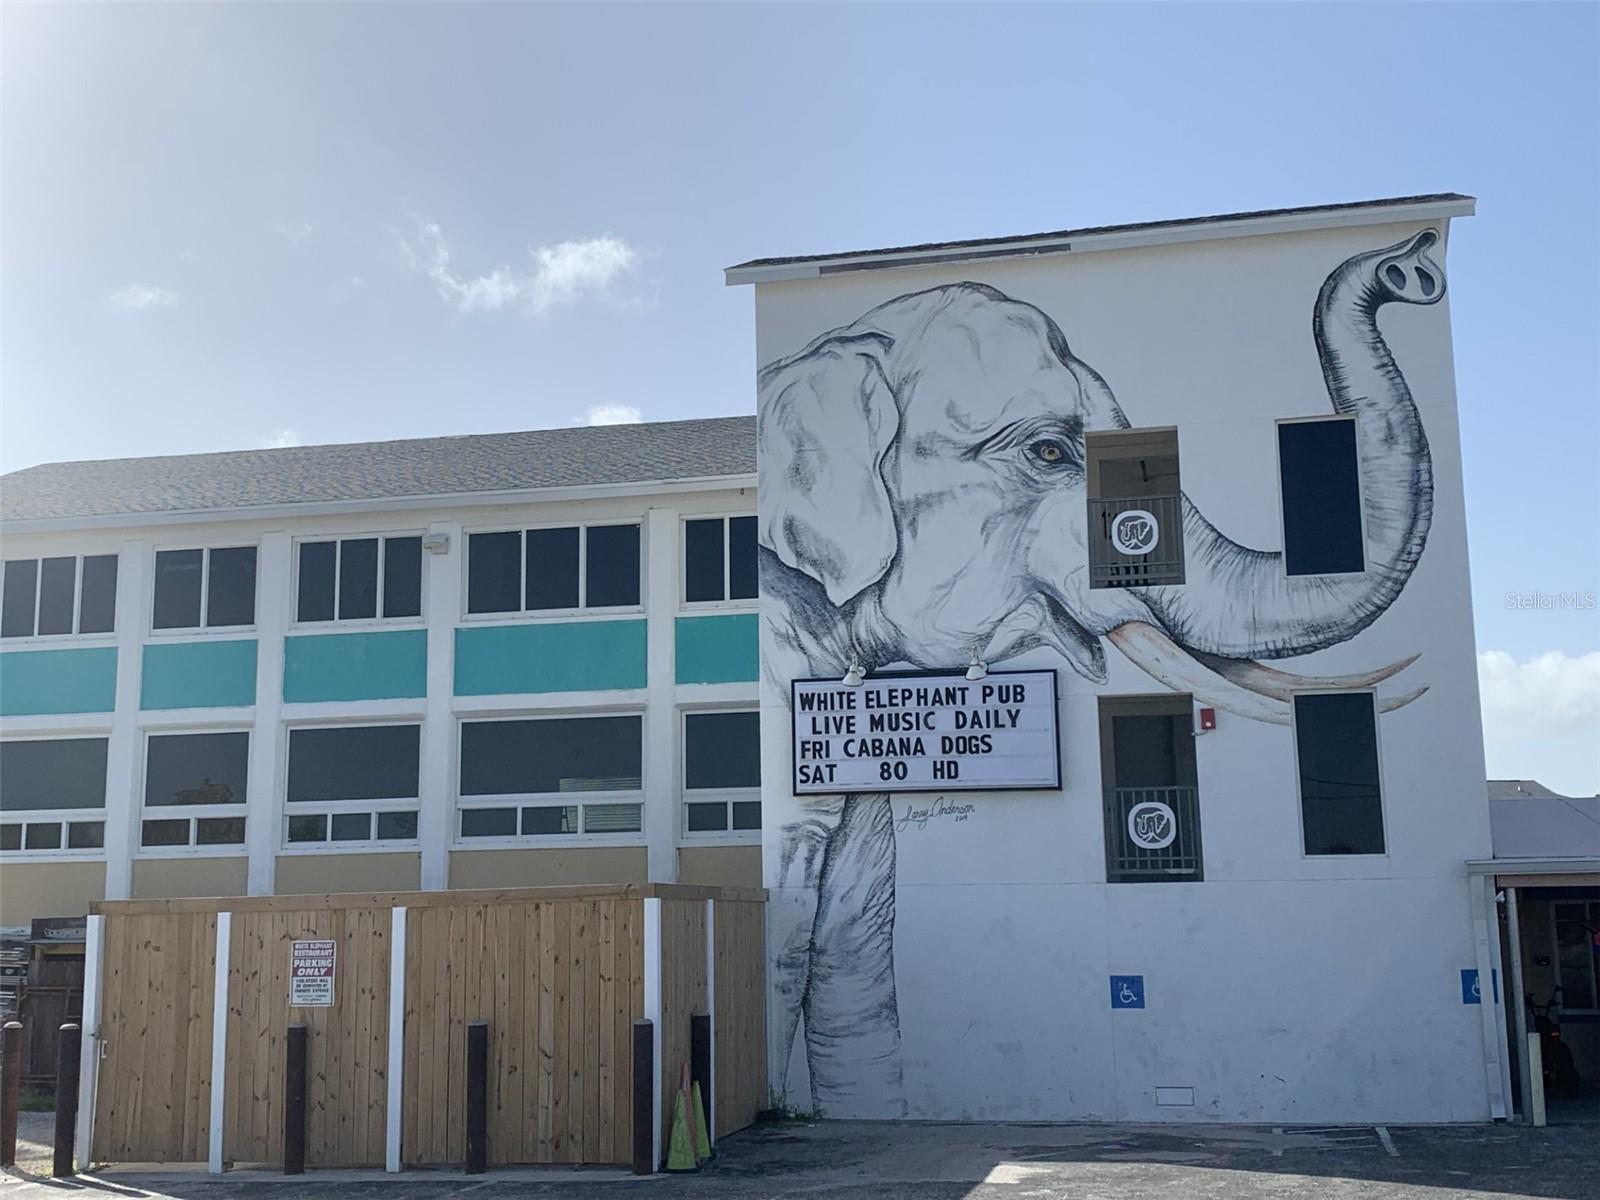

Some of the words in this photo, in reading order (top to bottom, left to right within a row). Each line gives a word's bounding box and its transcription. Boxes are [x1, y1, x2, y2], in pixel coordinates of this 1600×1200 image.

[799, 691, 857, 711] WHITE
[865, 687, 970, 709] ELEPHANT
[982, 684, 1026, 704] PUB
[812, 715, 857, 735] LIVE
[869, 711, 936, 733] MUSIC
[955, 709, 1021, 730] DAILY
[801, 740, 830, 760] FRI
[843, 737, 926, 758] CABANA
[941, 734, 993, 756] DOGS
[798, 764, 837, 784] SAT
[932, 760, 960, 780] HD
[294, 959, 333, 968] PARKING
[297, 968, 328, 976] ONLY
